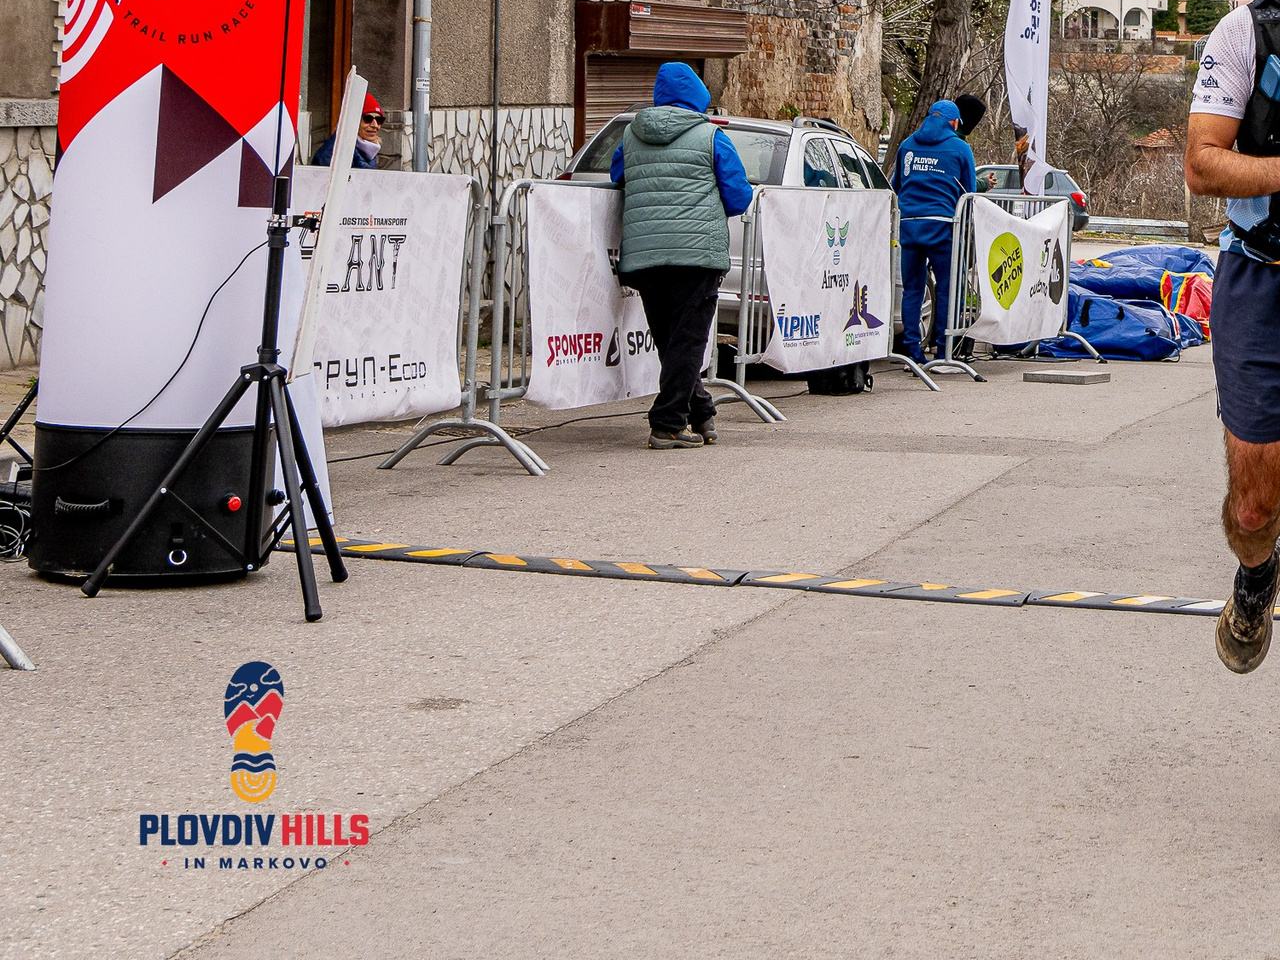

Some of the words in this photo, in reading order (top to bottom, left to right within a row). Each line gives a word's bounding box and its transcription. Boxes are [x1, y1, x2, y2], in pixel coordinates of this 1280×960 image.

[123, 10, 166, 42] TRAIL
[178, 30, 213, 44] RUN
[221, 0, 255, 34] RACE
[374, 217, 408, 226] TRANSPORT
